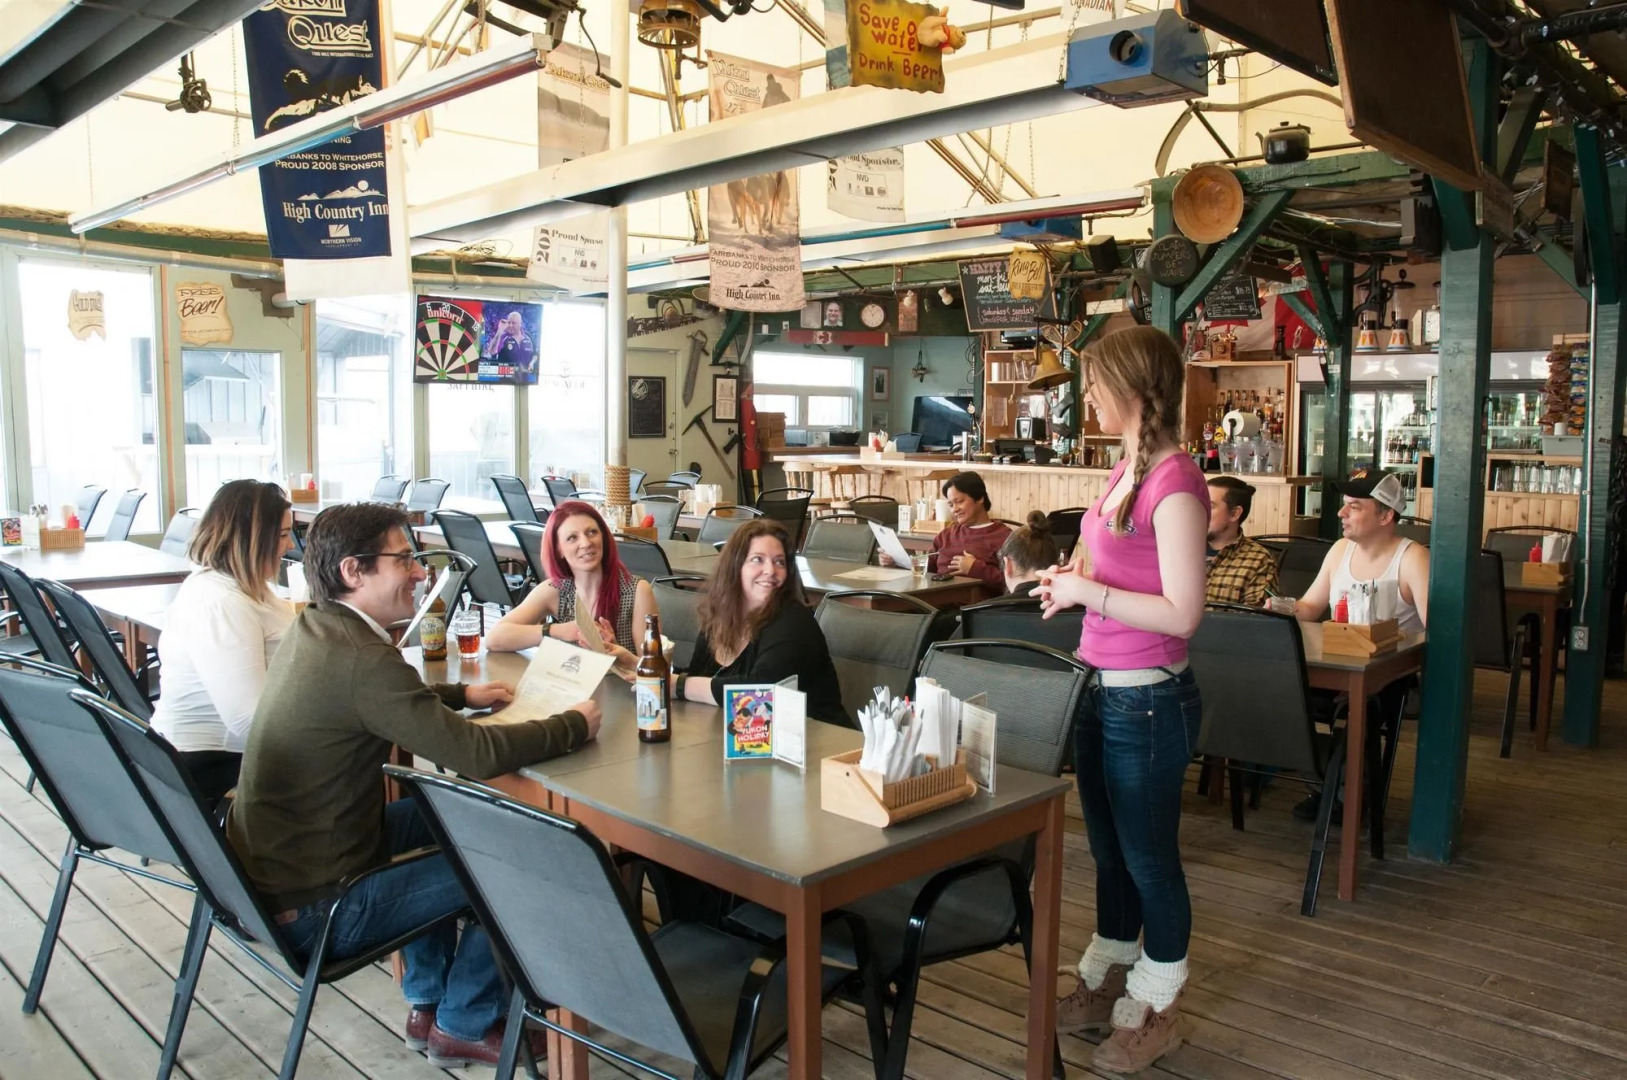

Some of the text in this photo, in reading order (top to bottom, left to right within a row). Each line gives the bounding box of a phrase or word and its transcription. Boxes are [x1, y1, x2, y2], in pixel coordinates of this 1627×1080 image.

[859, 2, 899, 31] Save
[288, 15, 372, 50] Quest
[858, 52, 942, 85] Drink Beer!
[275, 159, 385, 171] PROUD 2008 SPONSOR
[331, 152, 384, 162] WHITEHORSE
[282, 200, 390, 224] High Country Inn
[710, 256, 741, 268] PROUD
[726, 287, 743, 300] High
[179, 295, 225, 318] Beer!
[738, 731, 770, 743] HOLIDAY
